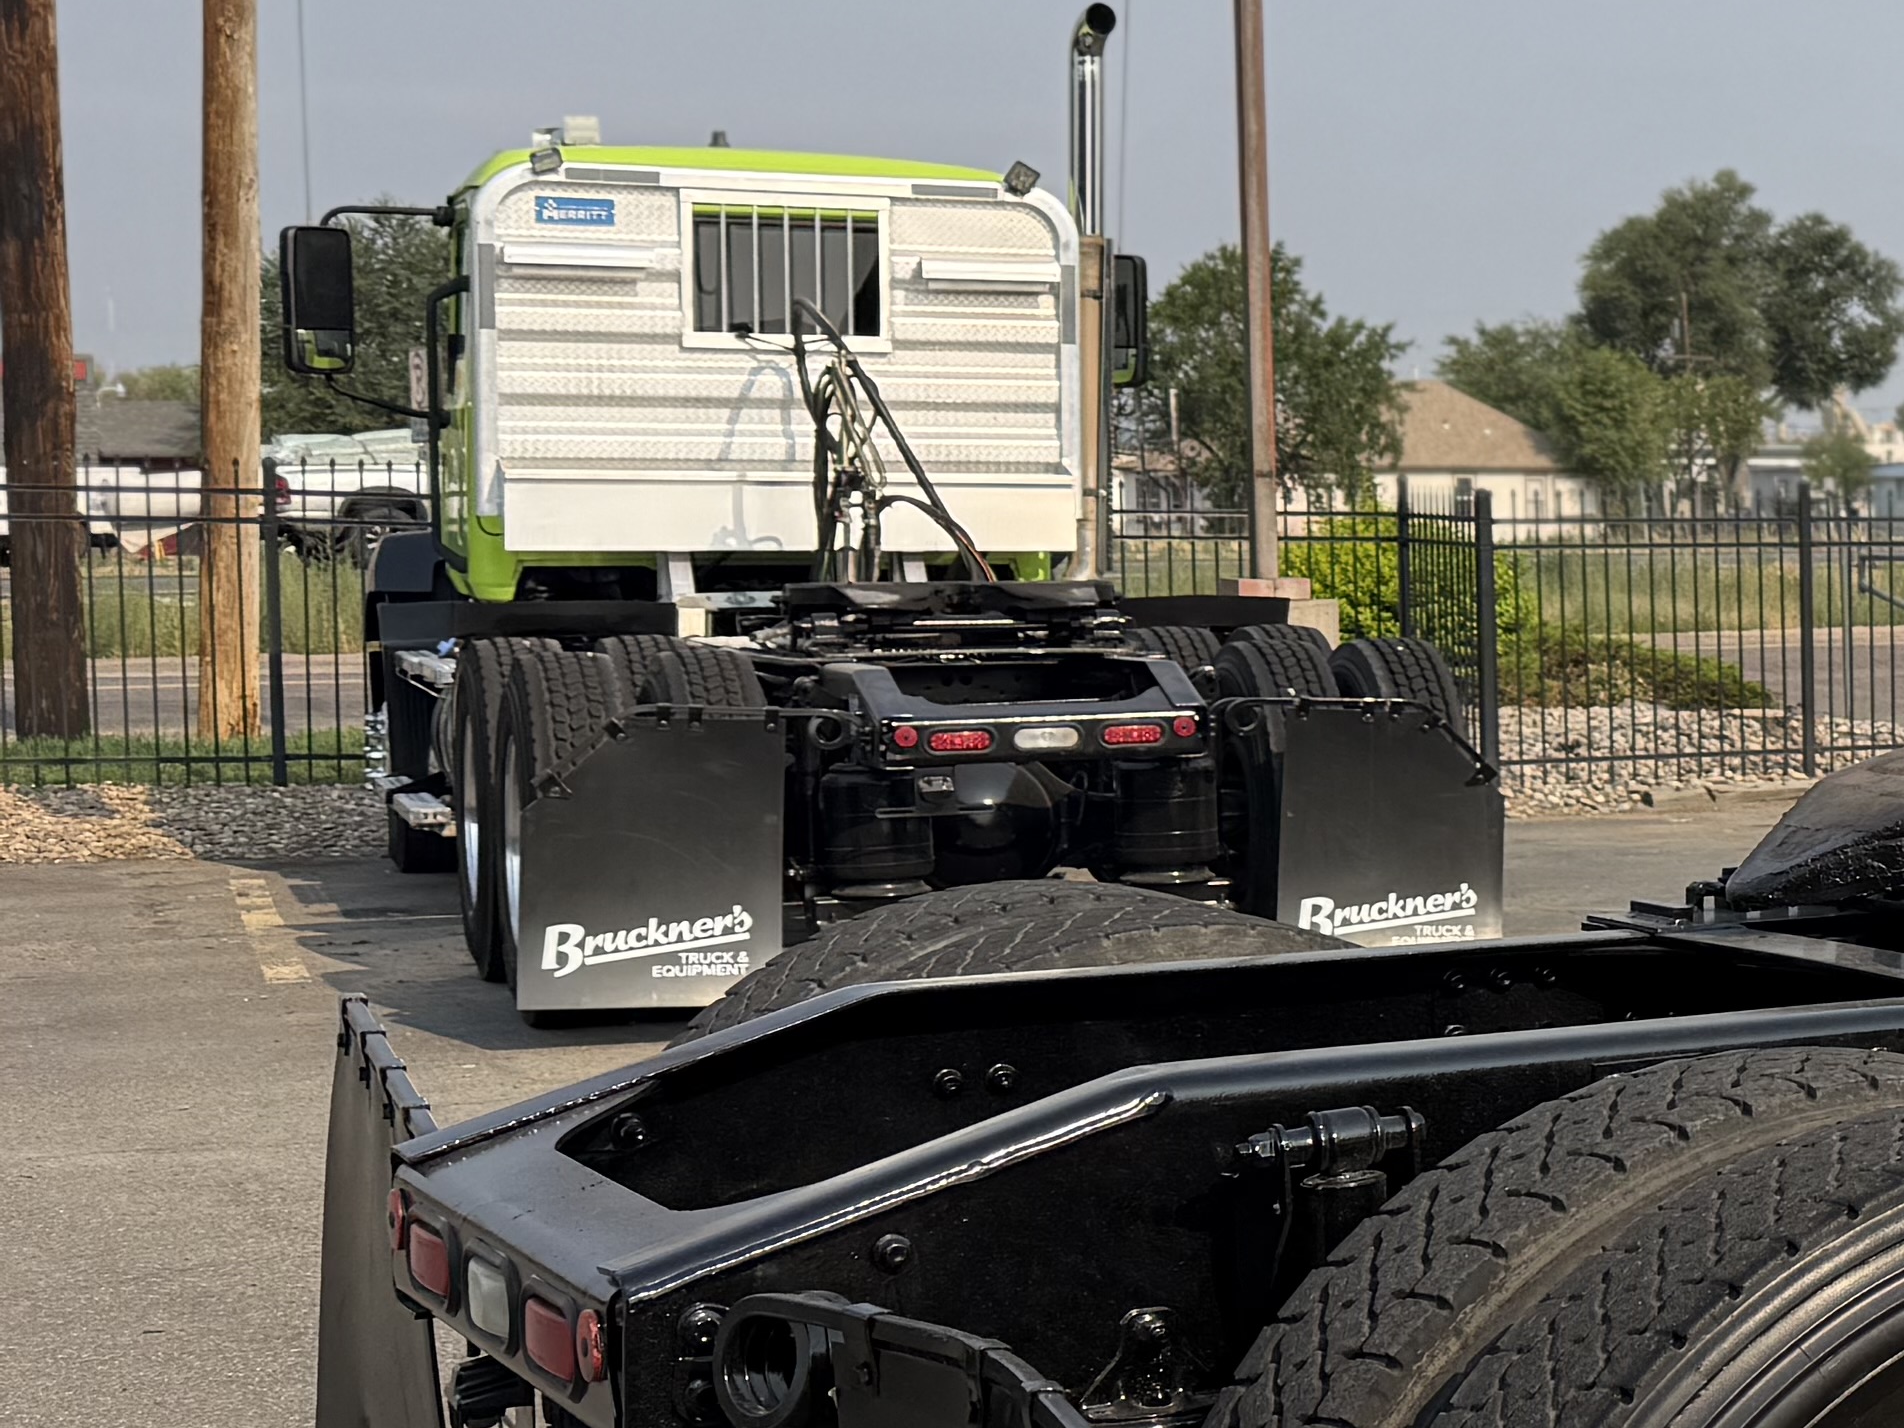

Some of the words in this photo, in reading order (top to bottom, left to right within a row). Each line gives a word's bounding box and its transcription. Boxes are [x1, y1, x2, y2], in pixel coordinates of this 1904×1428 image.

[542, 208, 609, 221] MERRITT
[1298, 882, 1478, 936] Bruckner's
[1413, 924, 1461, 936] TRUCK
[541, 904, 753, 978] Bruckner's
[677, 951, 735, 965] TRUCK
[736, 951, 750, 962] &
[651, 963, 750, 978] EQUIPMENT
